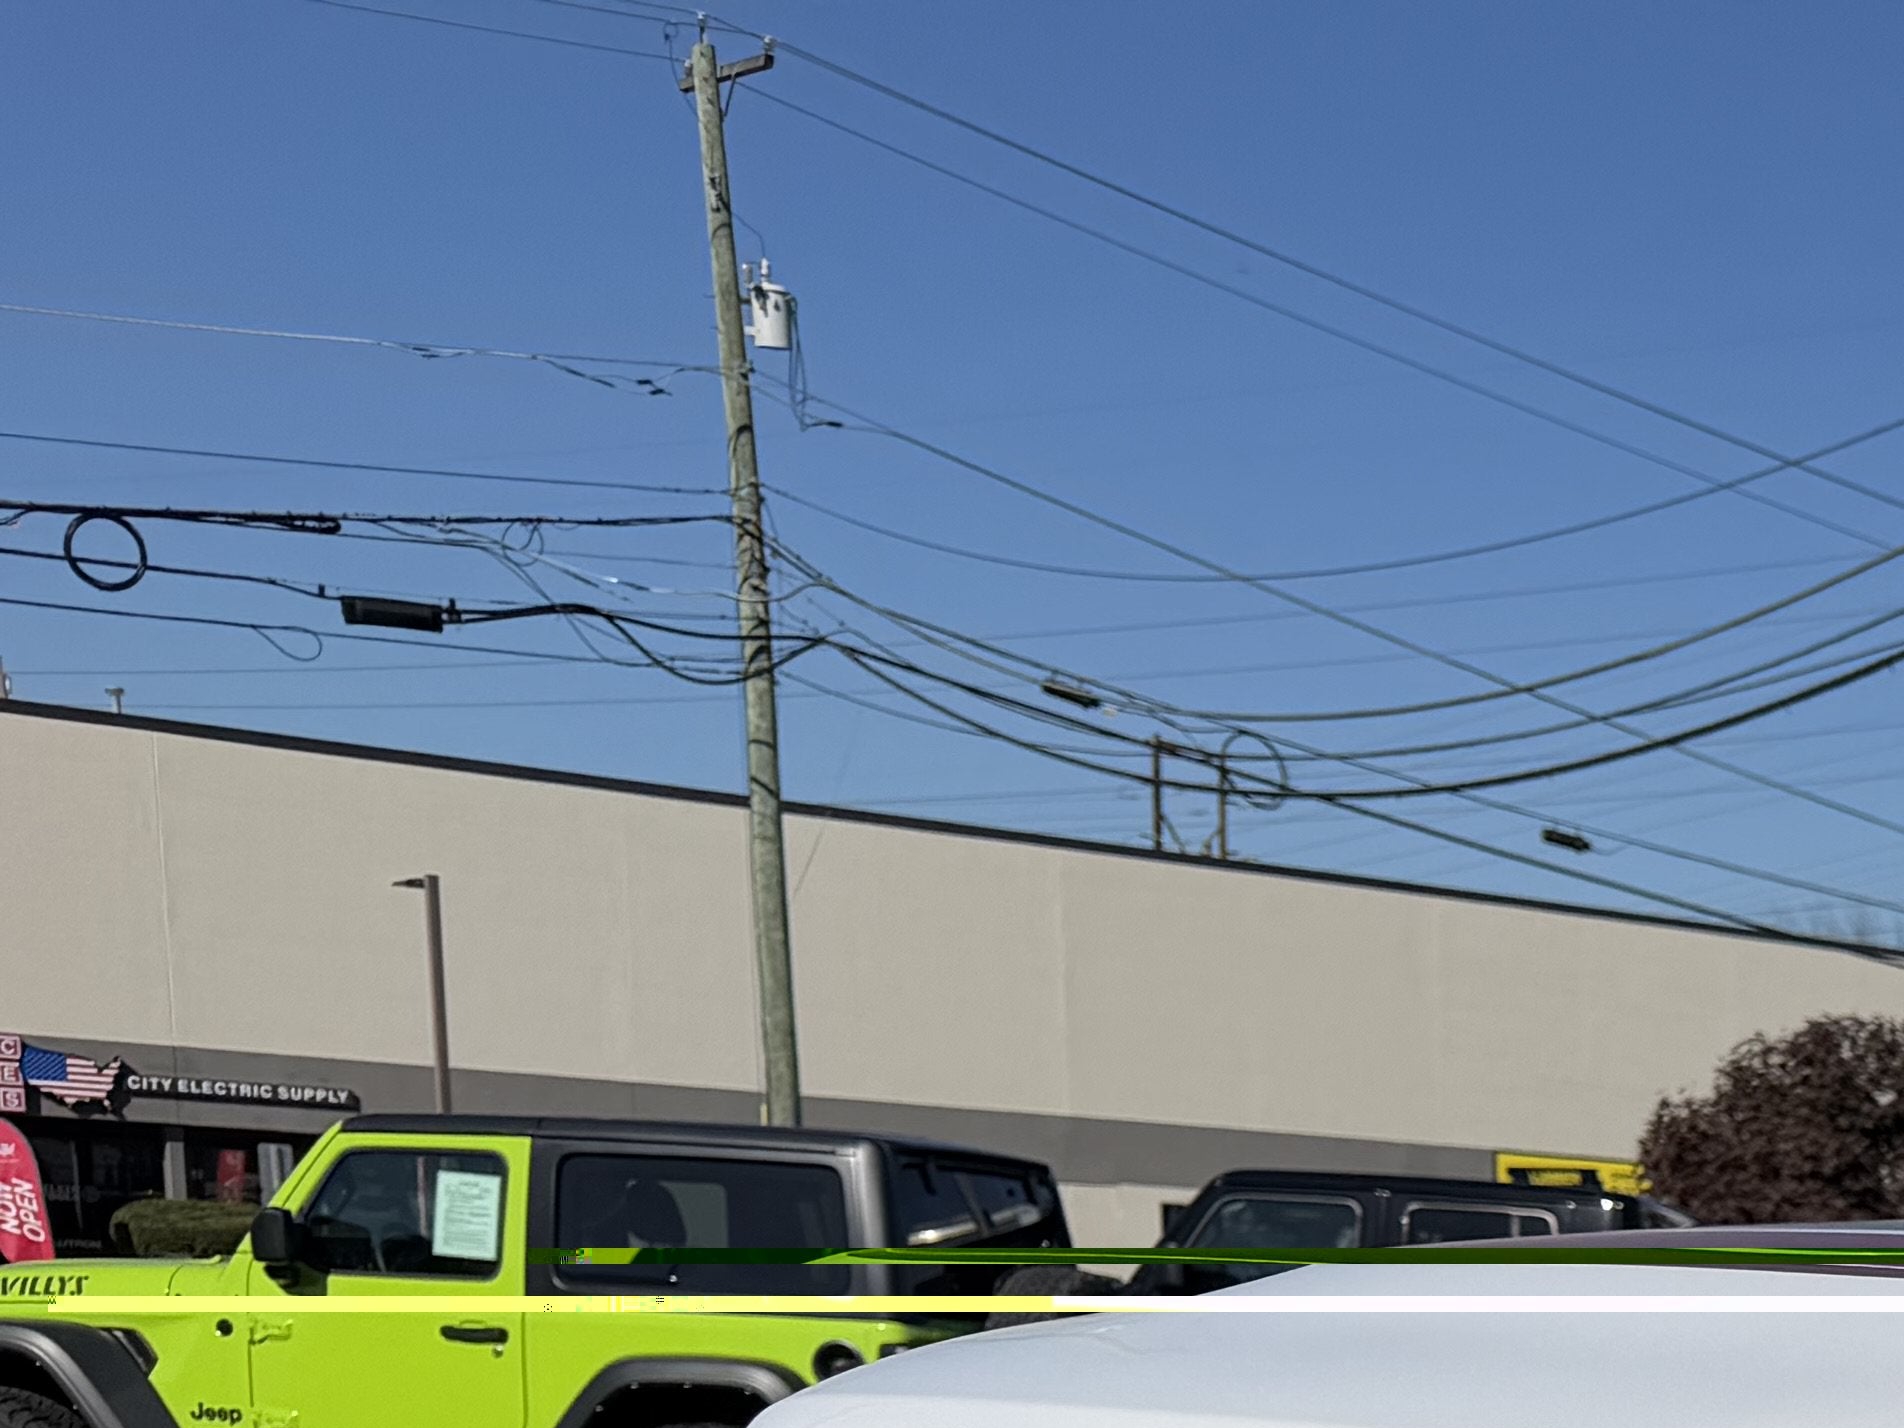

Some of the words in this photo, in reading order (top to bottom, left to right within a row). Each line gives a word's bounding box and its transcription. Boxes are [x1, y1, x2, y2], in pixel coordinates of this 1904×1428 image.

[127, 1075, 172, 1091] CITY
[177, 1079, 273, 1099] ELECTRIC
[277, 1085, 348, 1104] SUPPLY
[11, 1177, 46, 1243] OPEN
[190, 1402, 243, 1427] Jeep
